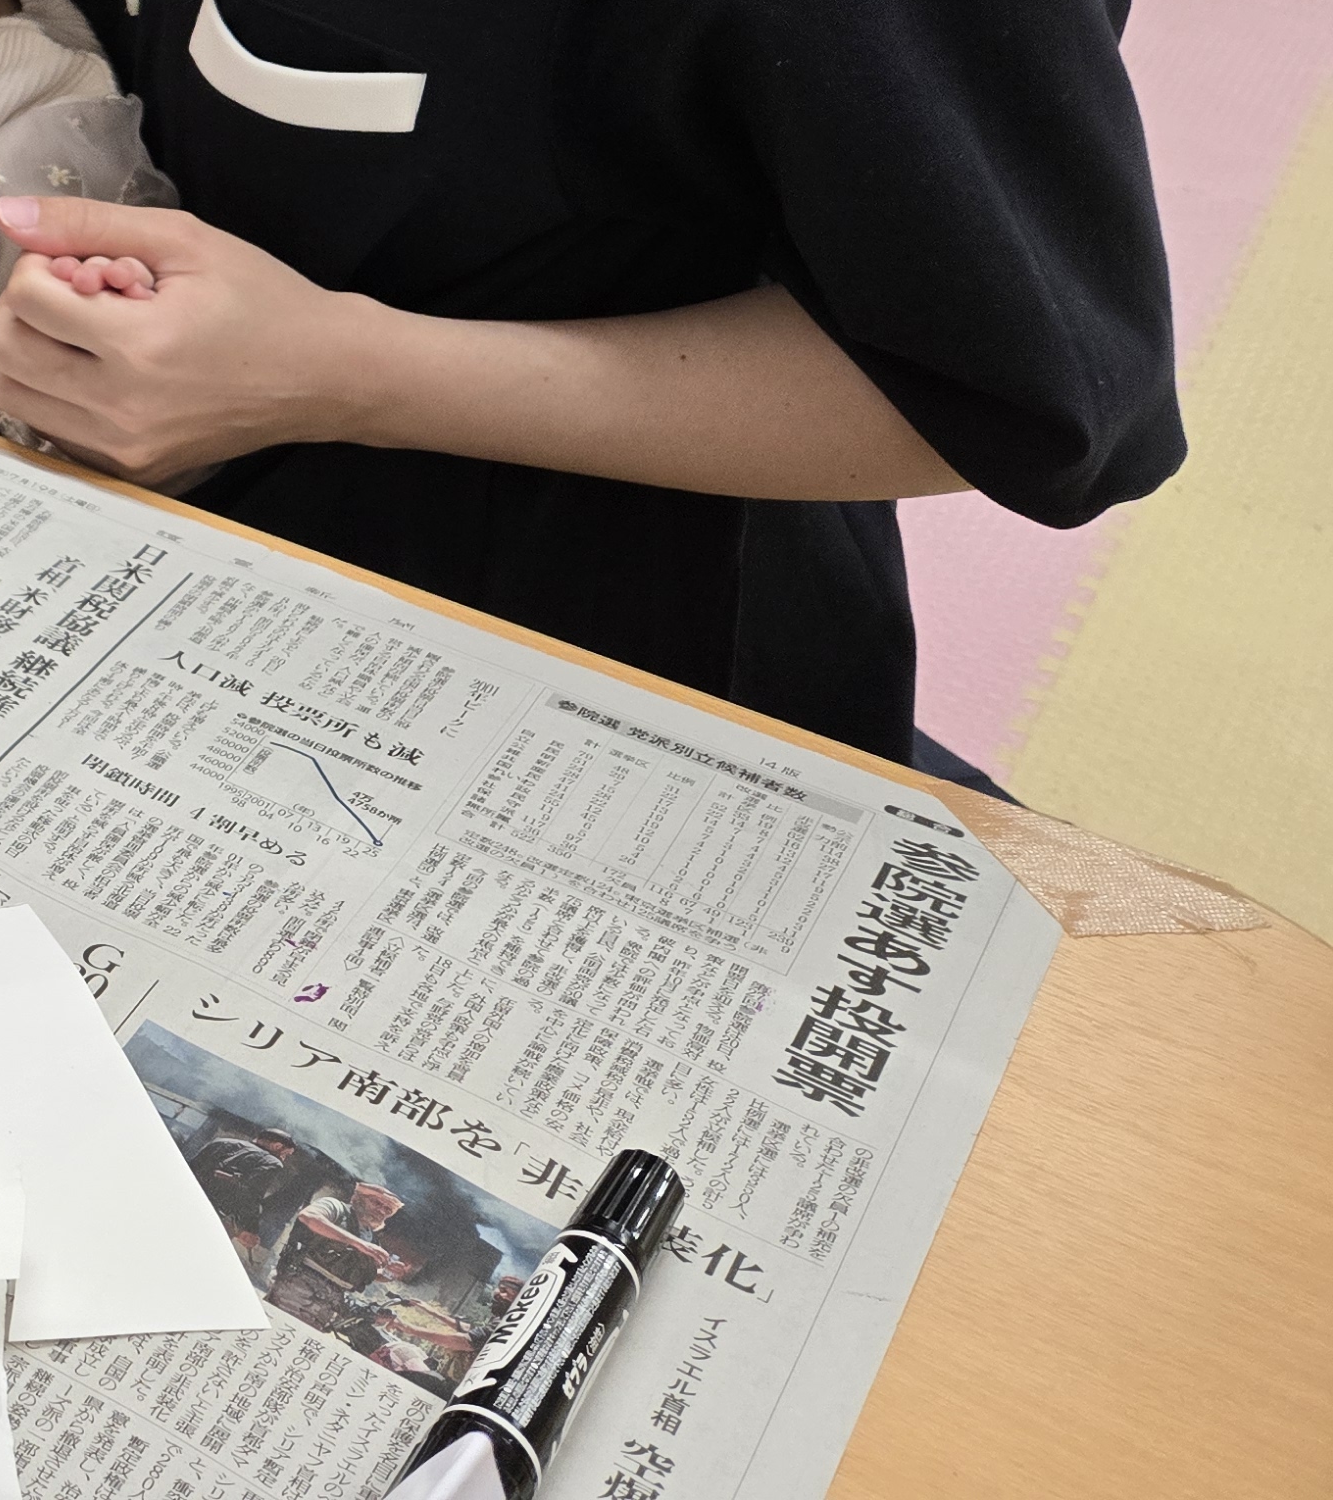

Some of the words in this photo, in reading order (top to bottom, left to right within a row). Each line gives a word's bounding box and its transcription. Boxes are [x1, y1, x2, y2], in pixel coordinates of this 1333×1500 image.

[35, 543, 172, 654] 日米関税協議
[158, 647, 255, 696] 人口減
[261, 690, 423, 765] 投票所も減
[204, 743, 243, 763] 48000
[212, 735, 251, 754] 50000
[220, 726, 259, 745] 52000
[251, 717, 419, 791] 参院選の当日投票所数の推移
[434, 680, 498, 738] 2001年ピークに
[557, 699, 620, 730] 参院選
[628, 726, 806, 801] 党派別立候補者数
[187, 761, 226, 782] 44000
[196, 752, 235, 772] 46000
[351, 790, 374, 803] 4万
[80, 754, 180, 807] 閉鎖時間
[189, 805, 309, 867] 4割早める
[216, 781, 245, 797] 1995
[243, 793, 271, 809] 2001
[276, 808, 294, 819] 07
[306, 821, 322, 832] 13
[334, 833, 351, 845] 19
[362, 846, 380, 858] 25
[229, 796, 247, 808] 98
[256, 808, 274, 820] 04
[285, 821, 303, 833] 10
[314, 834, 331, 845] 16
[341, 846, 360, 859] 22
[345, 797, 403, 824] 4758か所
[491, 869, 516, 890] なる。
[406, 944, 430, 962] た。
[608, 936, 677, 1025] 破内閣への評価が問われ
[632, 945, 702, 1036] り、昨年10月に発足した石
[656, 955, 725, 1047] 策などが争点となってお
[770, 839, 979, 1115] 参院選あす投開票
[493, 1008, 572, 1106] を中心に論戦が続いてい
[680, 964, 750, 1060] 開票日を迎える。物価高対
[517, 1018, 597, 1118] 定化に向けた農業政策など
[541, 1029, 622, 1131] 保障政策、コメ価格の安
[565, 1041, 647, 1144] 消費税減税の是非や、社会
[591, 1059, 667, 1157] 選挙戦では、現金給付や
[655, 1061, 696, 1106] 目に多い。
[201, 992, 770, 1309] シリア南部を「非化」
[695, 1100, 771, 1209] 比例選には172人の計5
[723, 1120, 795, 1218] 選挙区選には350人、
[775, 1136, 852, 1248] 合わせた125議席が争わ
[784, 1123, 826, 1170] れている。
[495, 1274, 548, 1343] Mckee
[146, 1326, 225, 1422] ア南部の非武装化
[200, 1324, 299, 1453] スカスから南の地域に展開
[226, 1338, 324, 1469] 政権の治安部隊が首都ダマ
[253, 1354, 351, 1486] 17日の声明で、シリア暫定
[563, 1353, 587, 1398] ゼブラ
[647, 1311, 734, 1435] イスラエル首相
[280, 1367, 380, 1500] ヤミン・ネタニヤフ首相は
